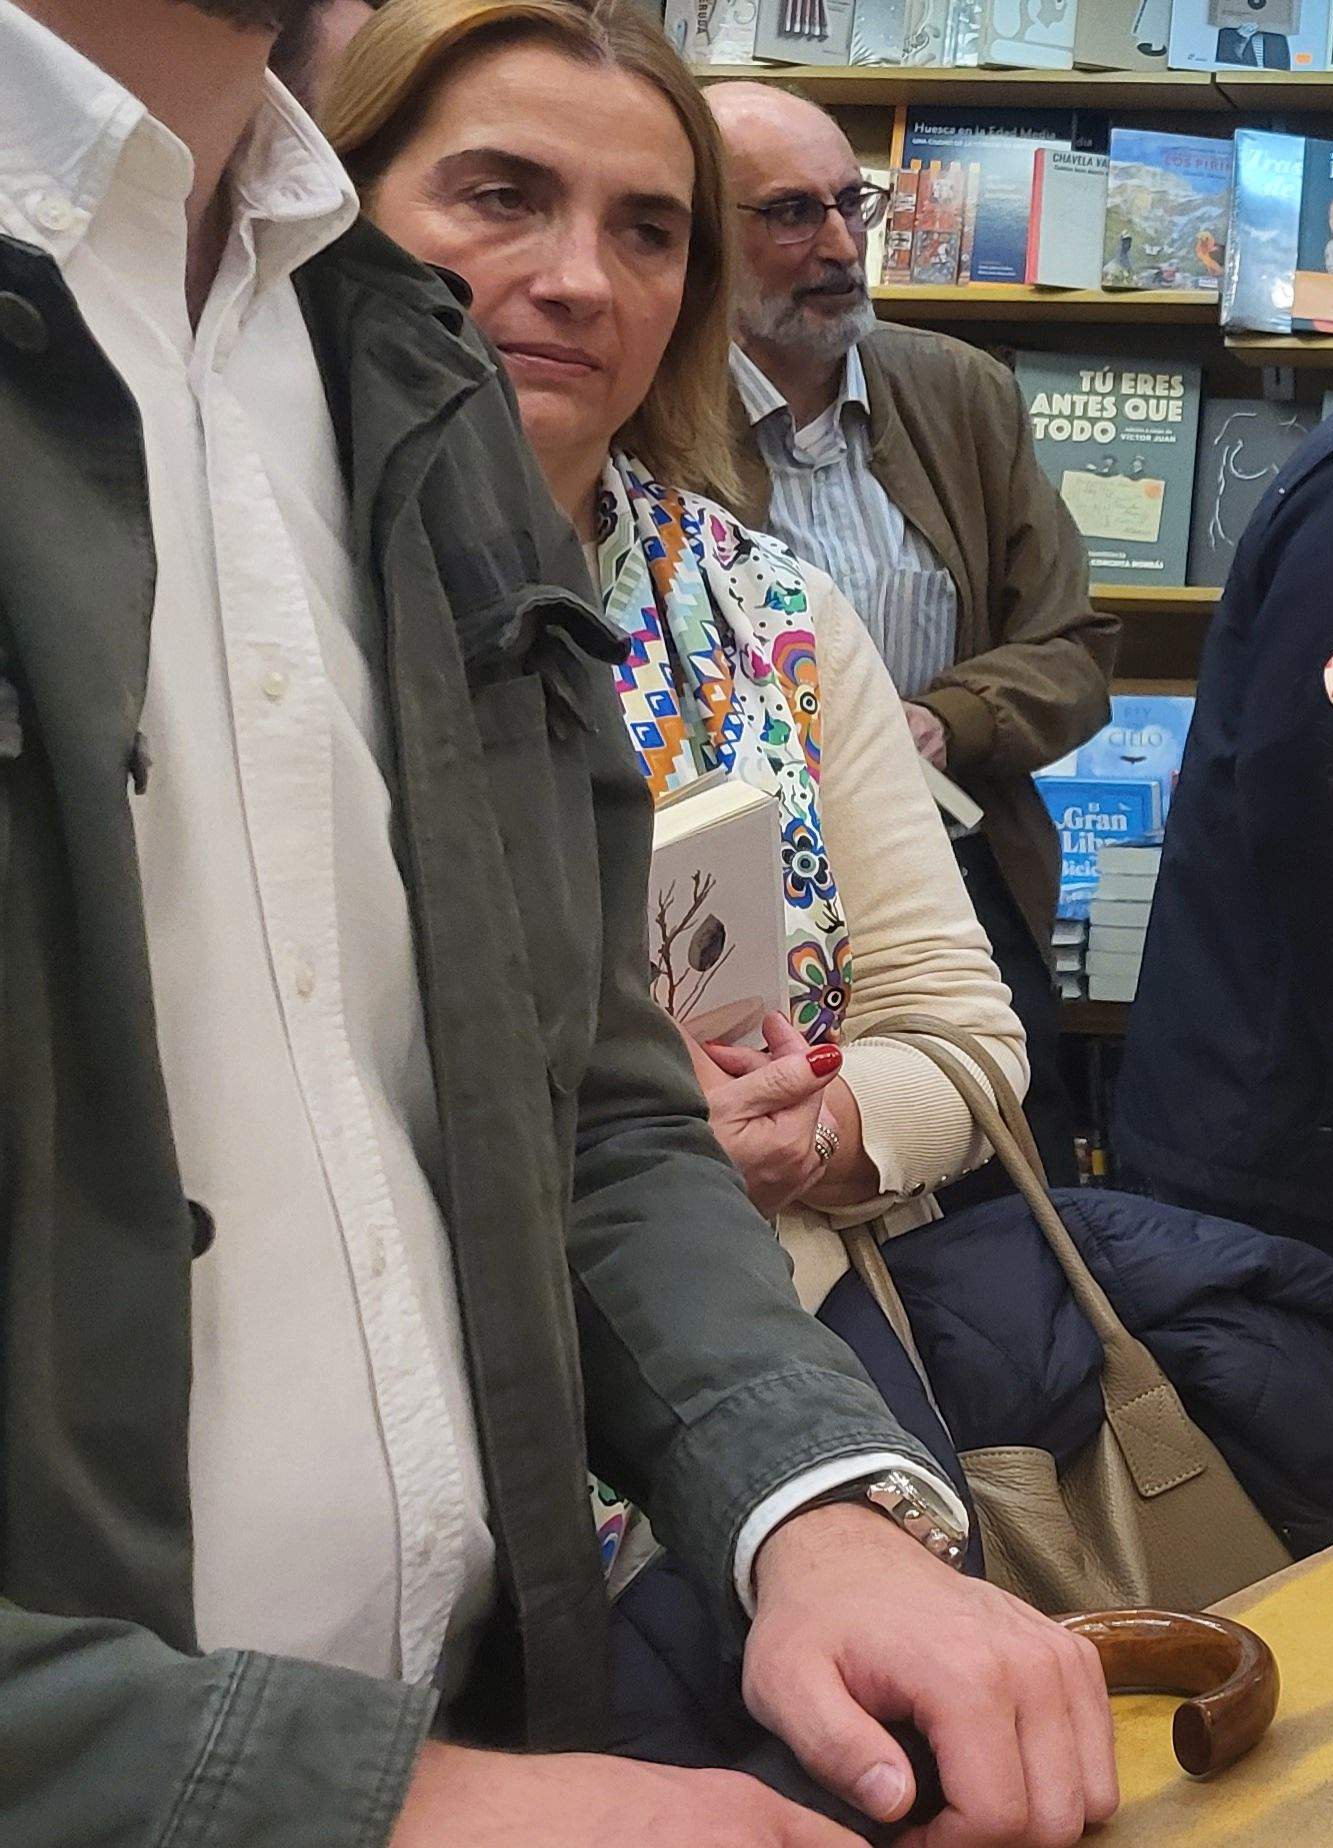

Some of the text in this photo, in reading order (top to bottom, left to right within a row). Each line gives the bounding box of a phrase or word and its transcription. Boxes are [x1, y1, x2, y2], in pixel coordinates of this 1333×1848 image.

[913, 121, 956, 135] Huesca
[957, 126, 973, 136] en
[1052, 152, 1094, 167] CHAVELA
[1079, 365, 1185, 398] TÚ ERES
[1028, 392, 1183, 423] ANTES QUE
[1032, 417, 1117, 444] TODO
[1063, 806, 1128, 832] Gran
